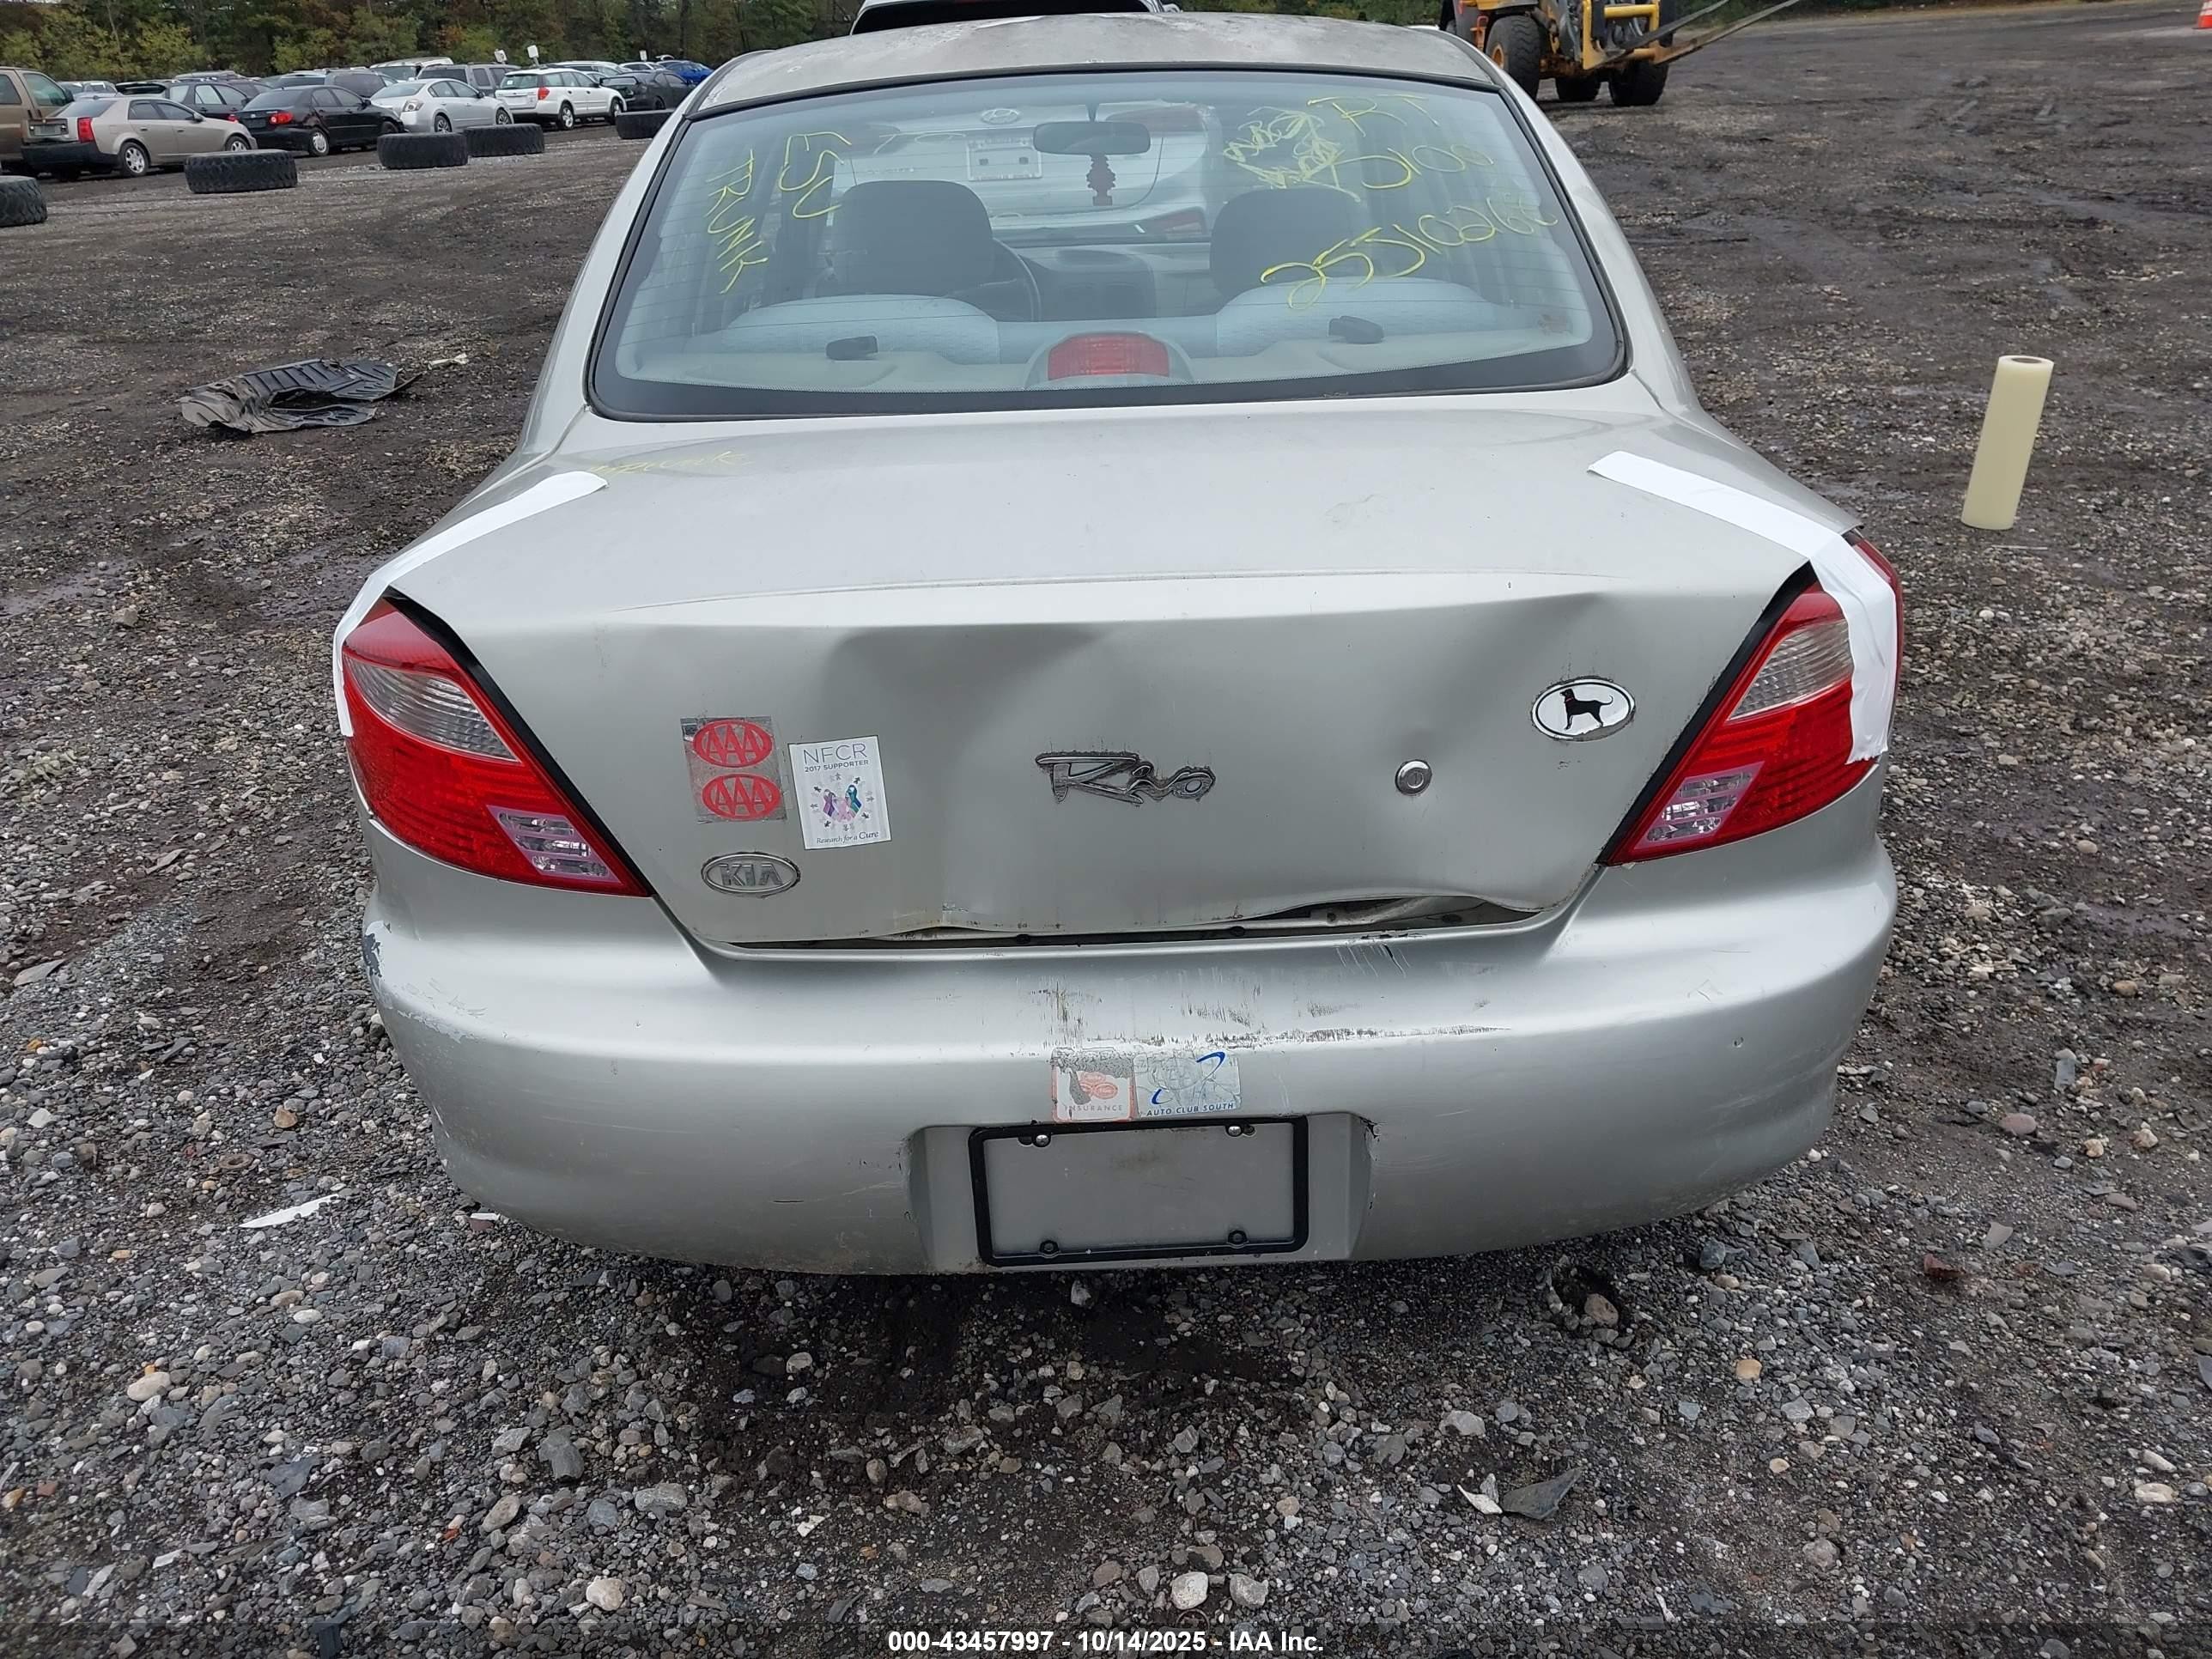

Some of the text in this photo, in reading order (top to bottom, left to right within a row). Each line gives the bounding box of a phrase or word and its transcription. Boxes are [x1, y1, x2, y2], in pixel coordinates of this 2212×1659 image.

[705, 149, 769, 295] TRUNK
[702, 721, 767, 766] AAA
[803, 743, 867, 764] NFCR
[823, 759, 869, 770] SUPPORTER
[711, 774, 775, 818] AAA
[718, 863, 783, 886] KIA
[1064, 1103, 1123, 1112] INSURANCE
[1146, 1102, 1235, 1117] AUTO CLUB SOUTH
